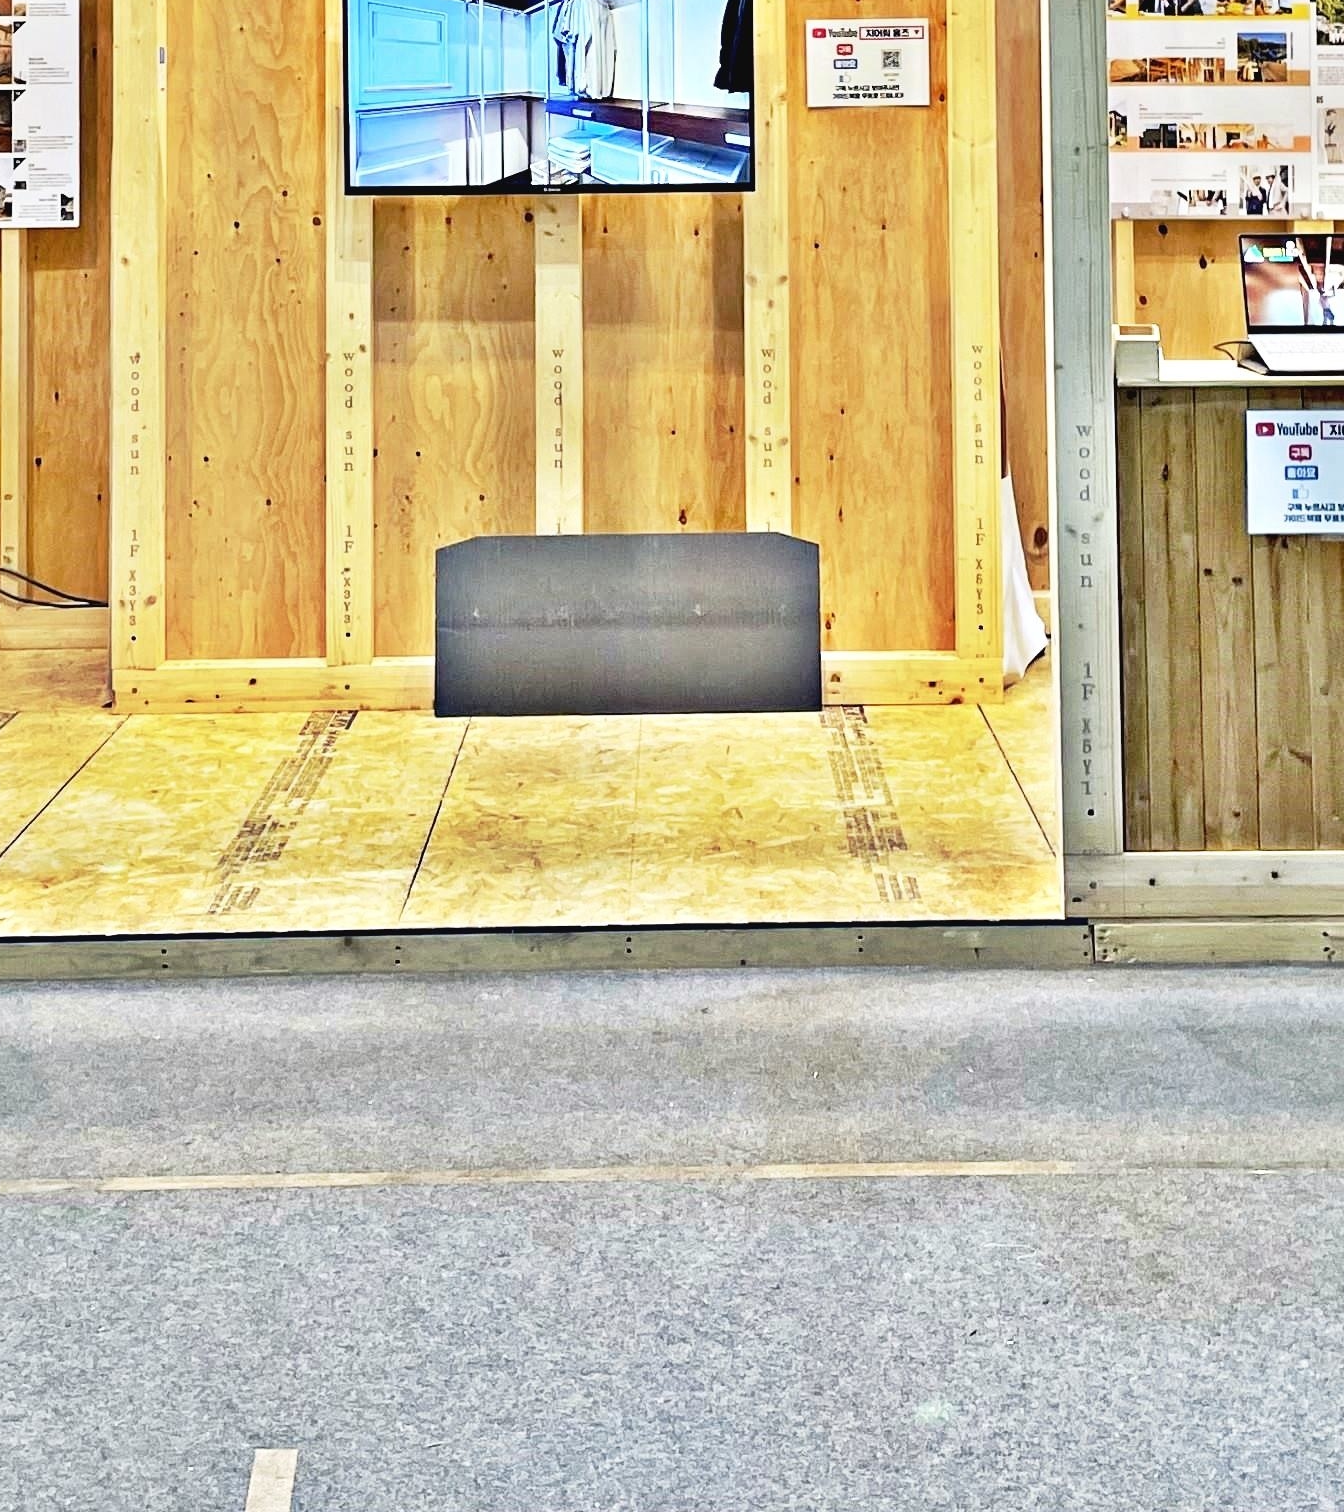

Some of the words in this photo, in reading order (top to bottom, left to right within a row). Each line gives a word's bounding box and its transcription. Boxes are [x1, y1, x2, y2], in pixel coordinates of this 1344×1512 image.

[129, 352, 142, 413] wood
[342, 350, 355, 410] wood
[552, 348, 564, 406] wood
[761, 348, 774, 405] wood
[971, 344, 984, 402] wood
[554, 427, 563, 469] sun
[763, 426, 773, 468] sun
[974, 422, 984, 465] sun
[1276, 422, 1319, 436] YouTube
[130, 433, 140, 476] sun
[344, 430, 354, 472] sun
[1075, 424, 1092, 502] wood
[130, 529, 141, 558] 1F
[344, 525, 354, 555] 1F
[976, 517, 985, 546] 1F
[1079, 531, 1093, 589] sun
[1081, 662, 1095, 700] 1F
